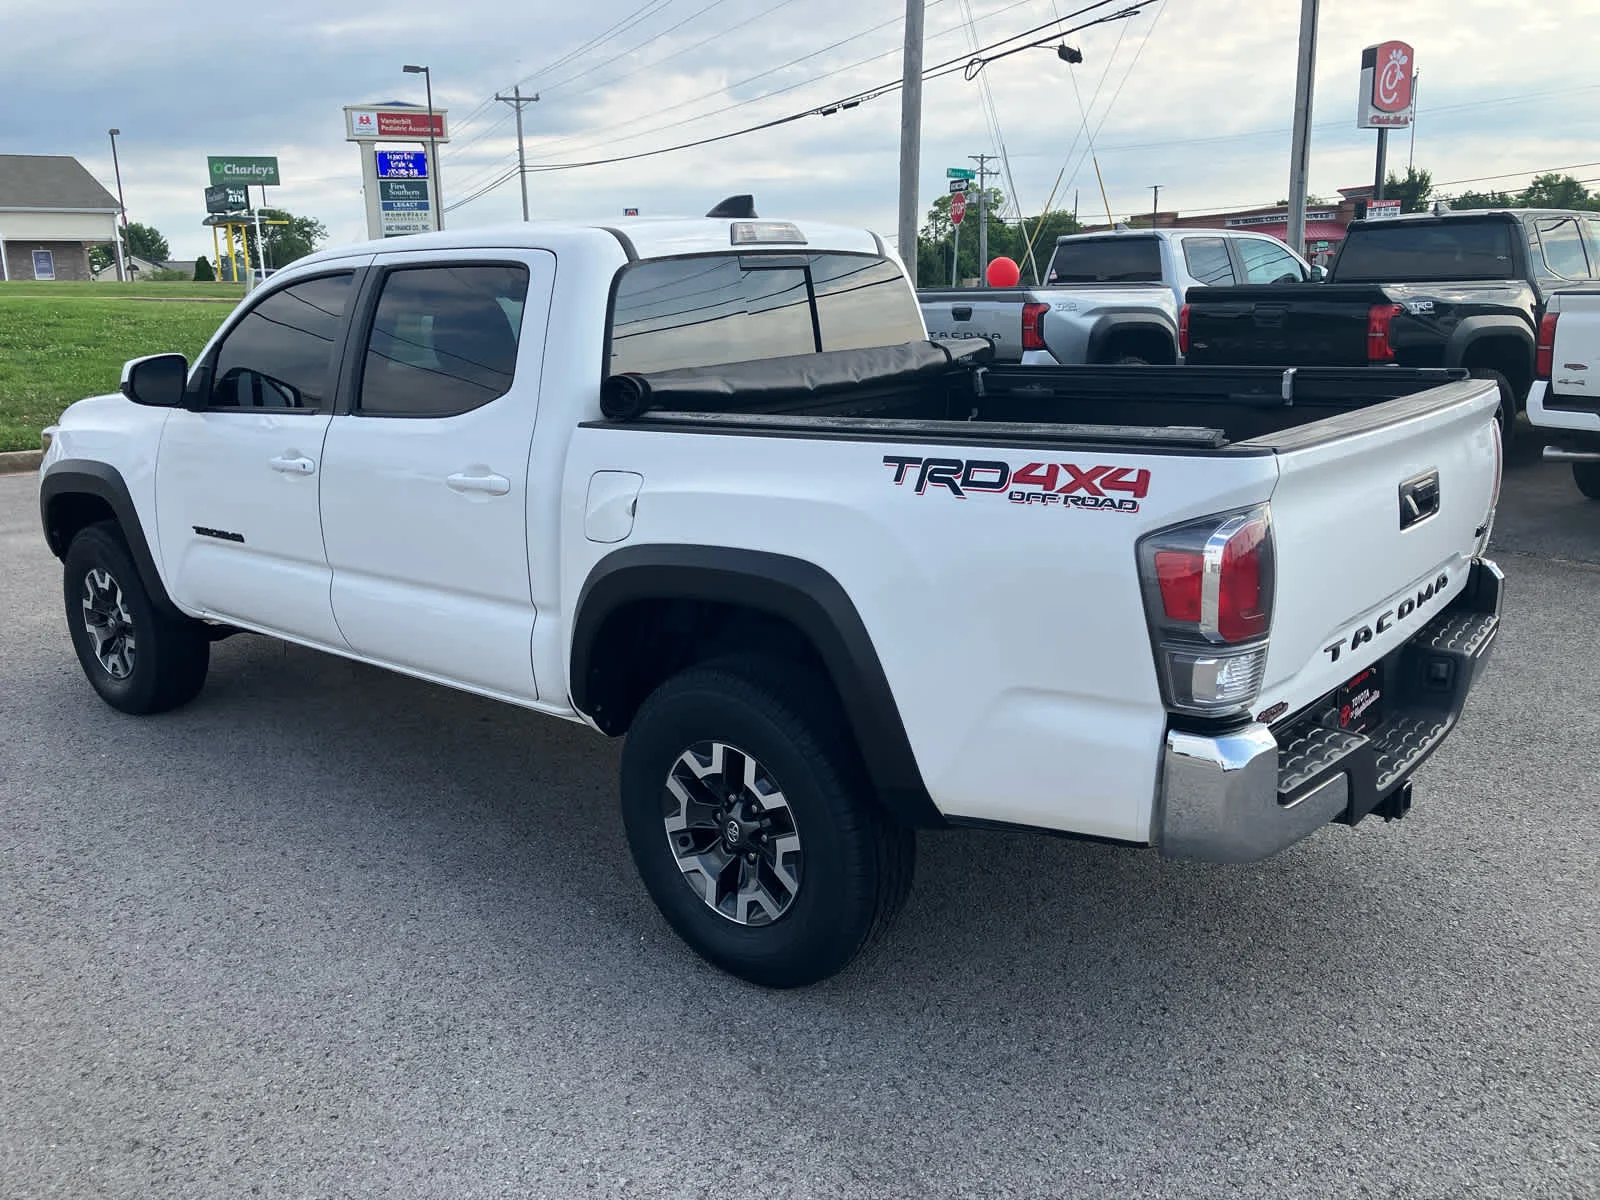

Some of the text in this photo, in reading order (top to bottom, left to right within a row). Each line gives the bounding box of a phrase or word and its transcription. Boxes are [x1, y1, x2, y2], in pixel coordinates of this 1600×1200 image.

[380, 117, 412, 125] Vanderbilt
[390, 182, 406, 191] First
[228, 194, 246, 203] ATM
[951, 202, 965, 215] STOP
[883, 455, 1013, 499] TRD
[1007, 490, 1140, 514] OFF ROAD
[1323, 571, 1449, 663] TACOMA
[1351, 688, 1370, 708] TOYOTA
